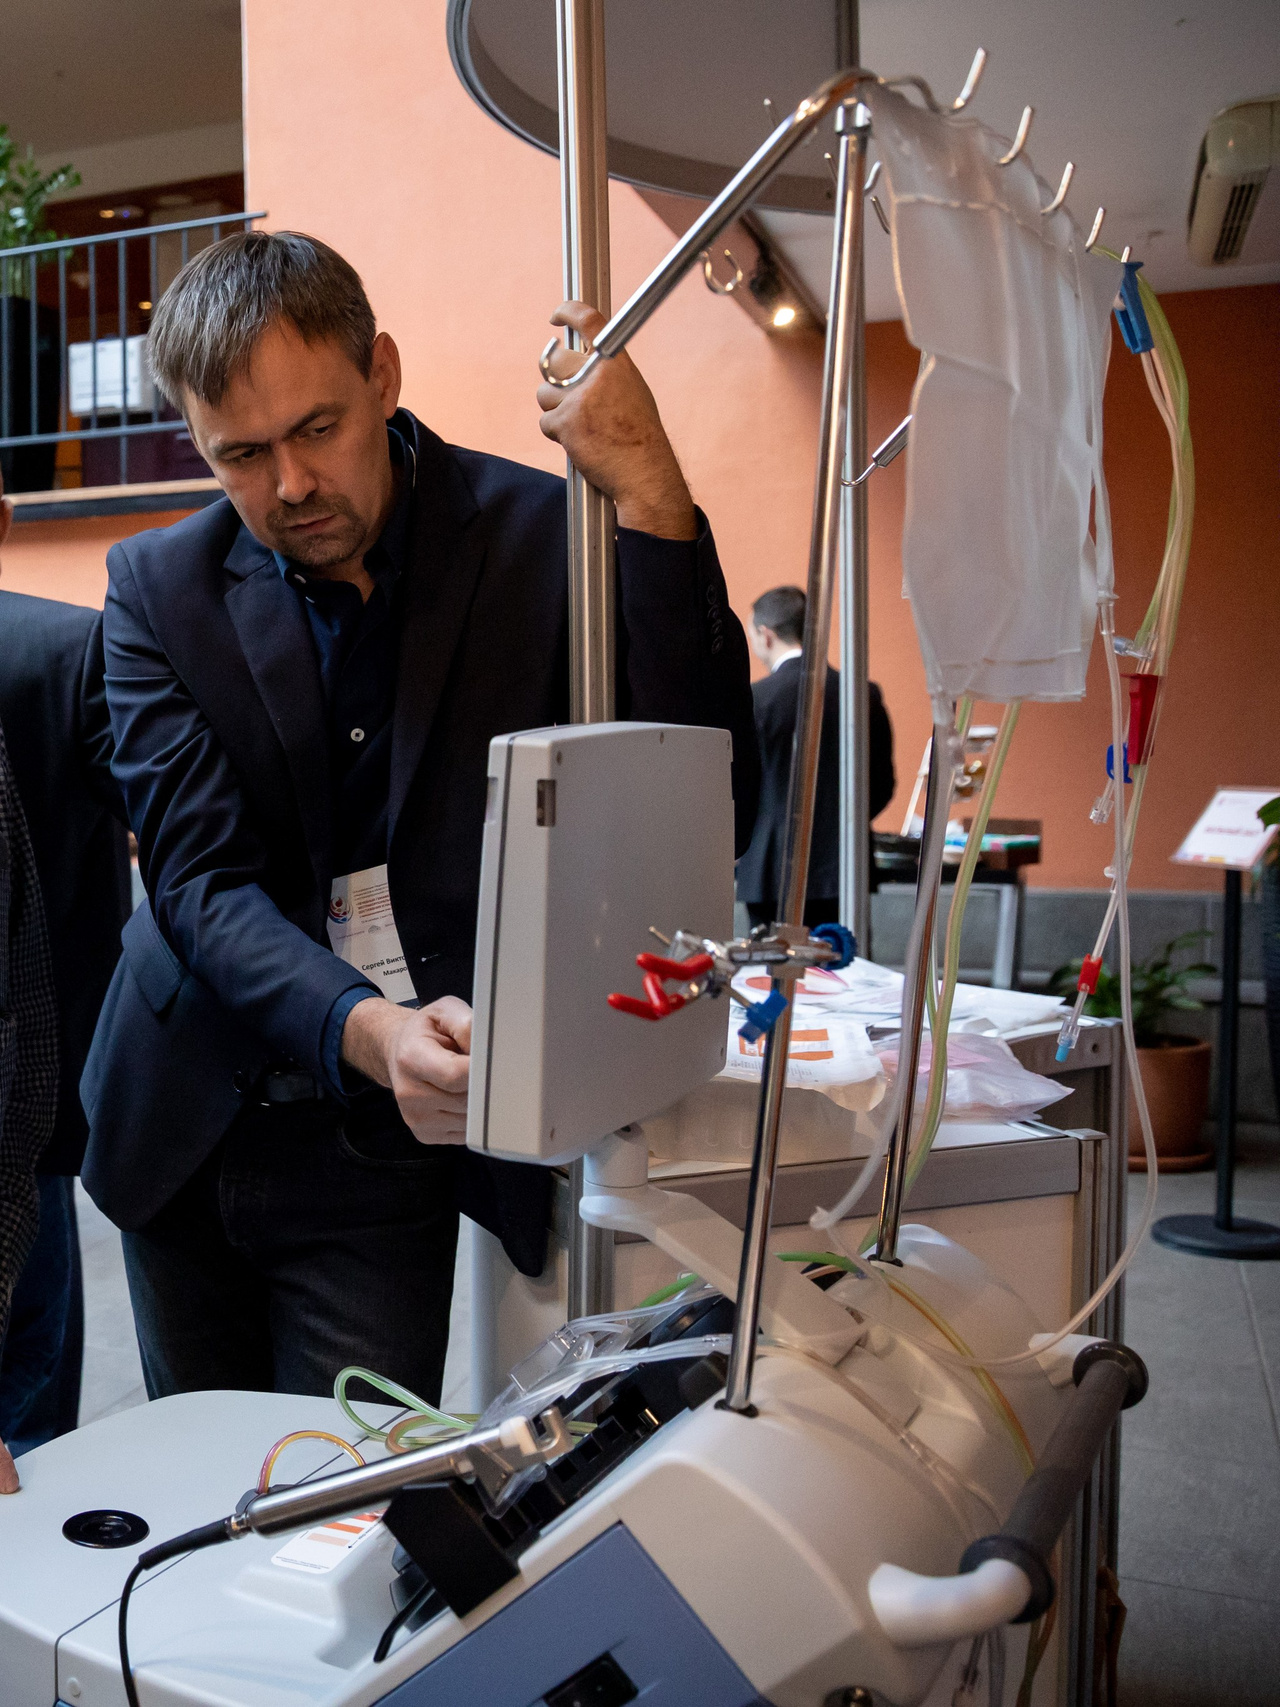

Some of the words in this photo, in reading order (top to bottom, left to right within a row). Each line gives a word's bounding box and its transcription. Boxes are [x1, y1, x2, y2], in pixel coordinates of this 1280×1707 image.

[361, 959, 386, 971] Сергей
[385, 955, 406, 965] Викто
[382, 966, 408, 976] Макаро
